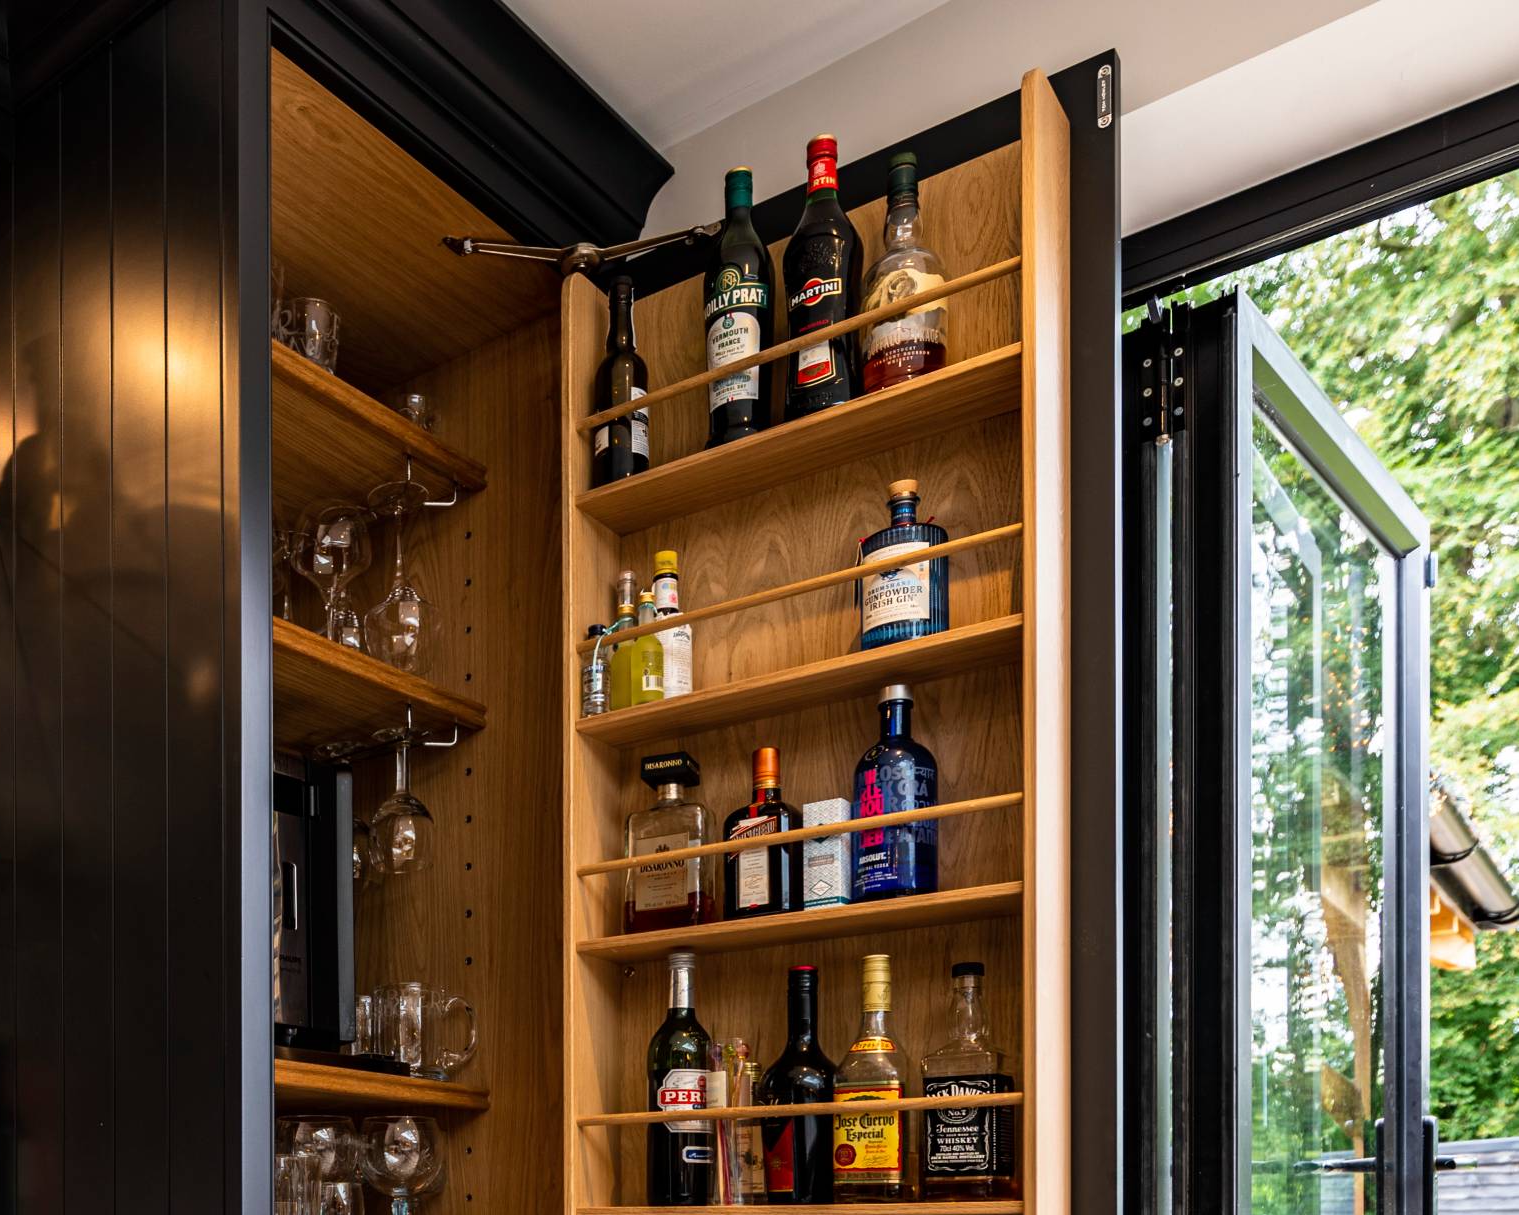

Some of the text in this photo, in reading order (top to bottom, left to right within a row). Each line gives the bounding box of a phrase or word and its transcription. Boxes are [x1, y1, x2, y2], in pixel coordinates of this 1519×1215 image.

[732, 287, 763, 304] PRAT
[791, 281, 838, 307] MARTINI
[712, 327, 749, 345] VERMOUTH
[717, 338, 741, 350] FRANCE
[865, 585, 923, 607] GUNPOWDER
[870, 595, 914, 611] IRISH GIN
[644, 759, 683, 770] DISARONNO
[835, 1112, 895, 1130] Jose Cuervo
[936, 1124, 980, 1133] Tennessee
[844, 1127, 884, 1142] Especial
